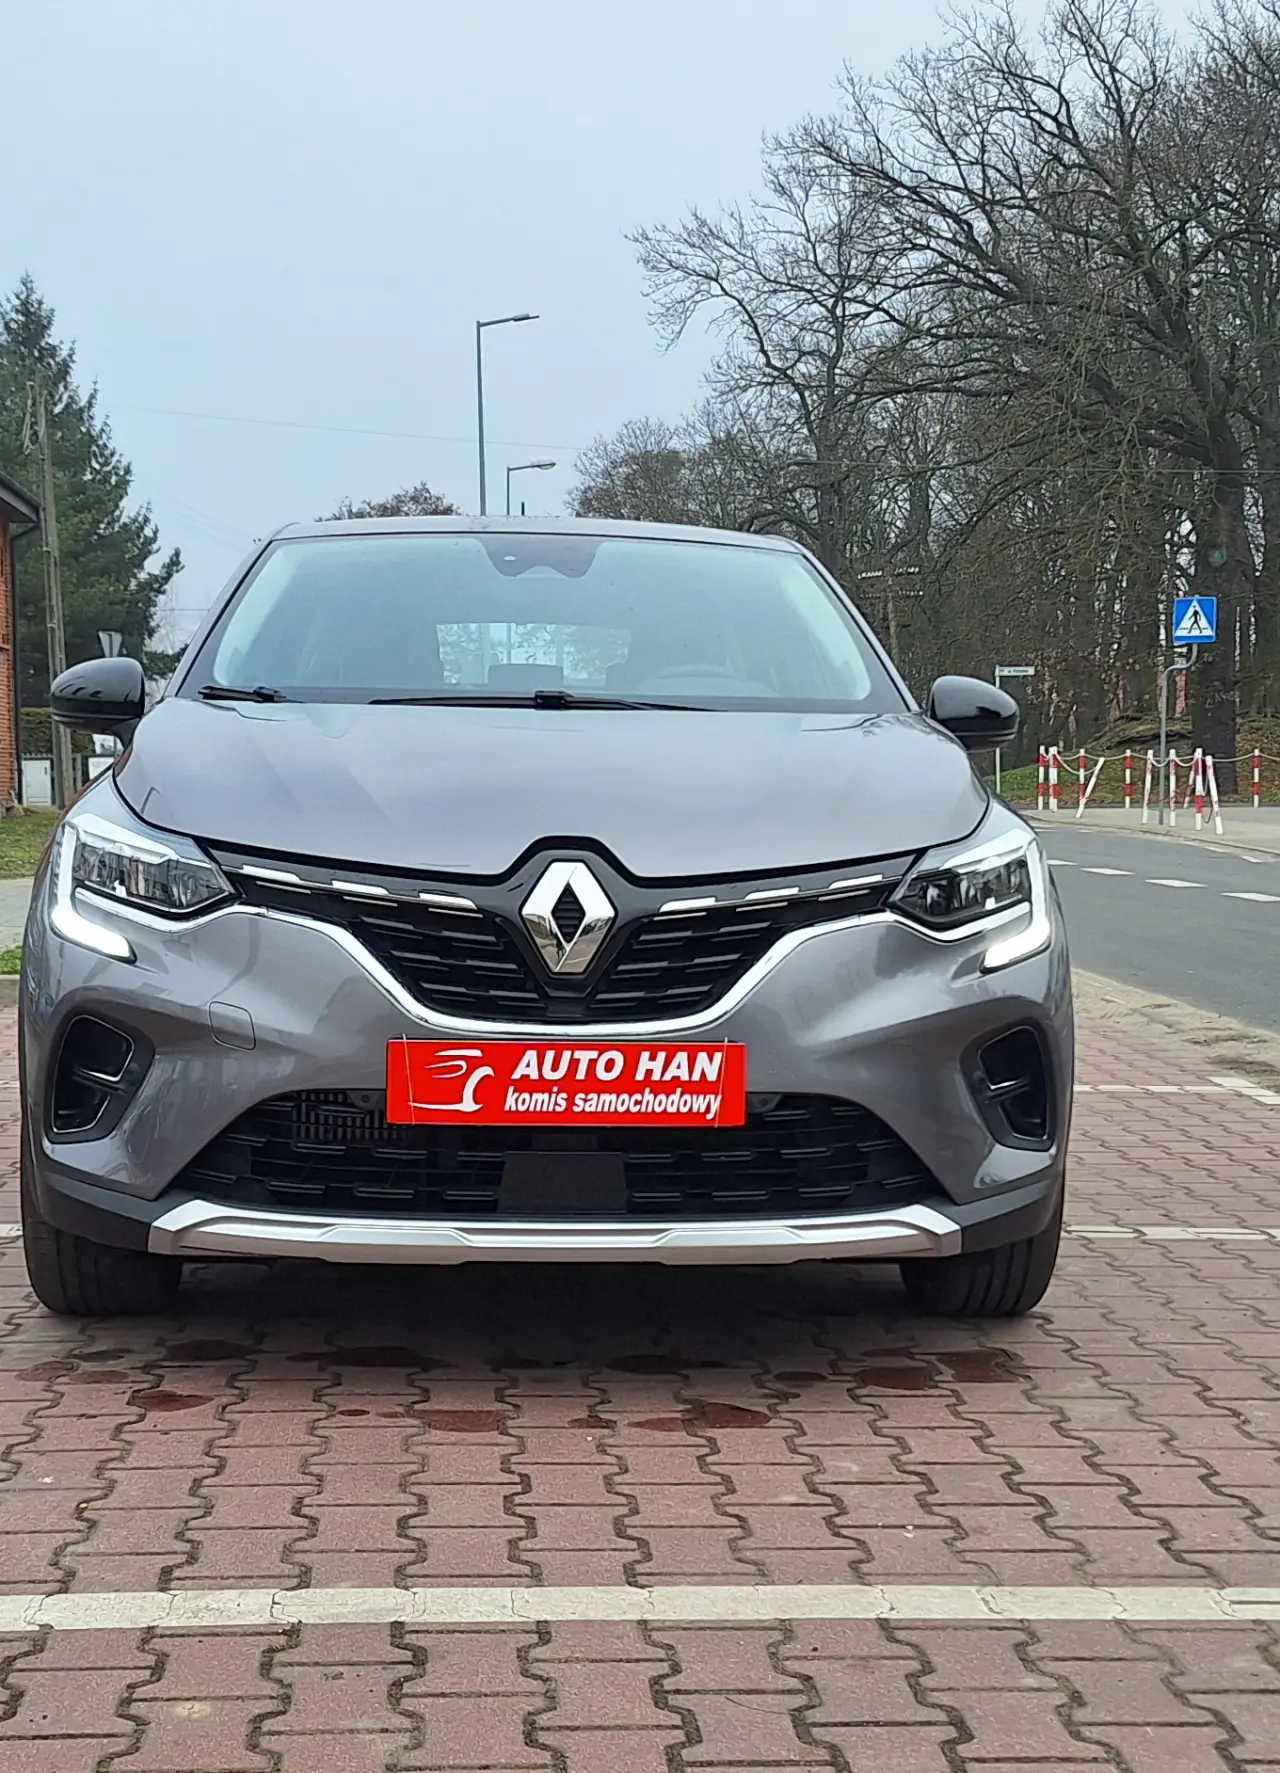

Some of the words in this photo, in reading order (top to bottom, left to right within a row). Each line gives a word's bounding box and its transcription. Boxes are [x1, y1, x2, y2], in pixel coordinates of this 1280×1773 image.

[511, 1050, 624, 1081] AUTO
[634, 1051, 723, 1082] HAN
[504, 1087, 567, 1112] komis
[572, 1088, 723, 1119] samochodowy
